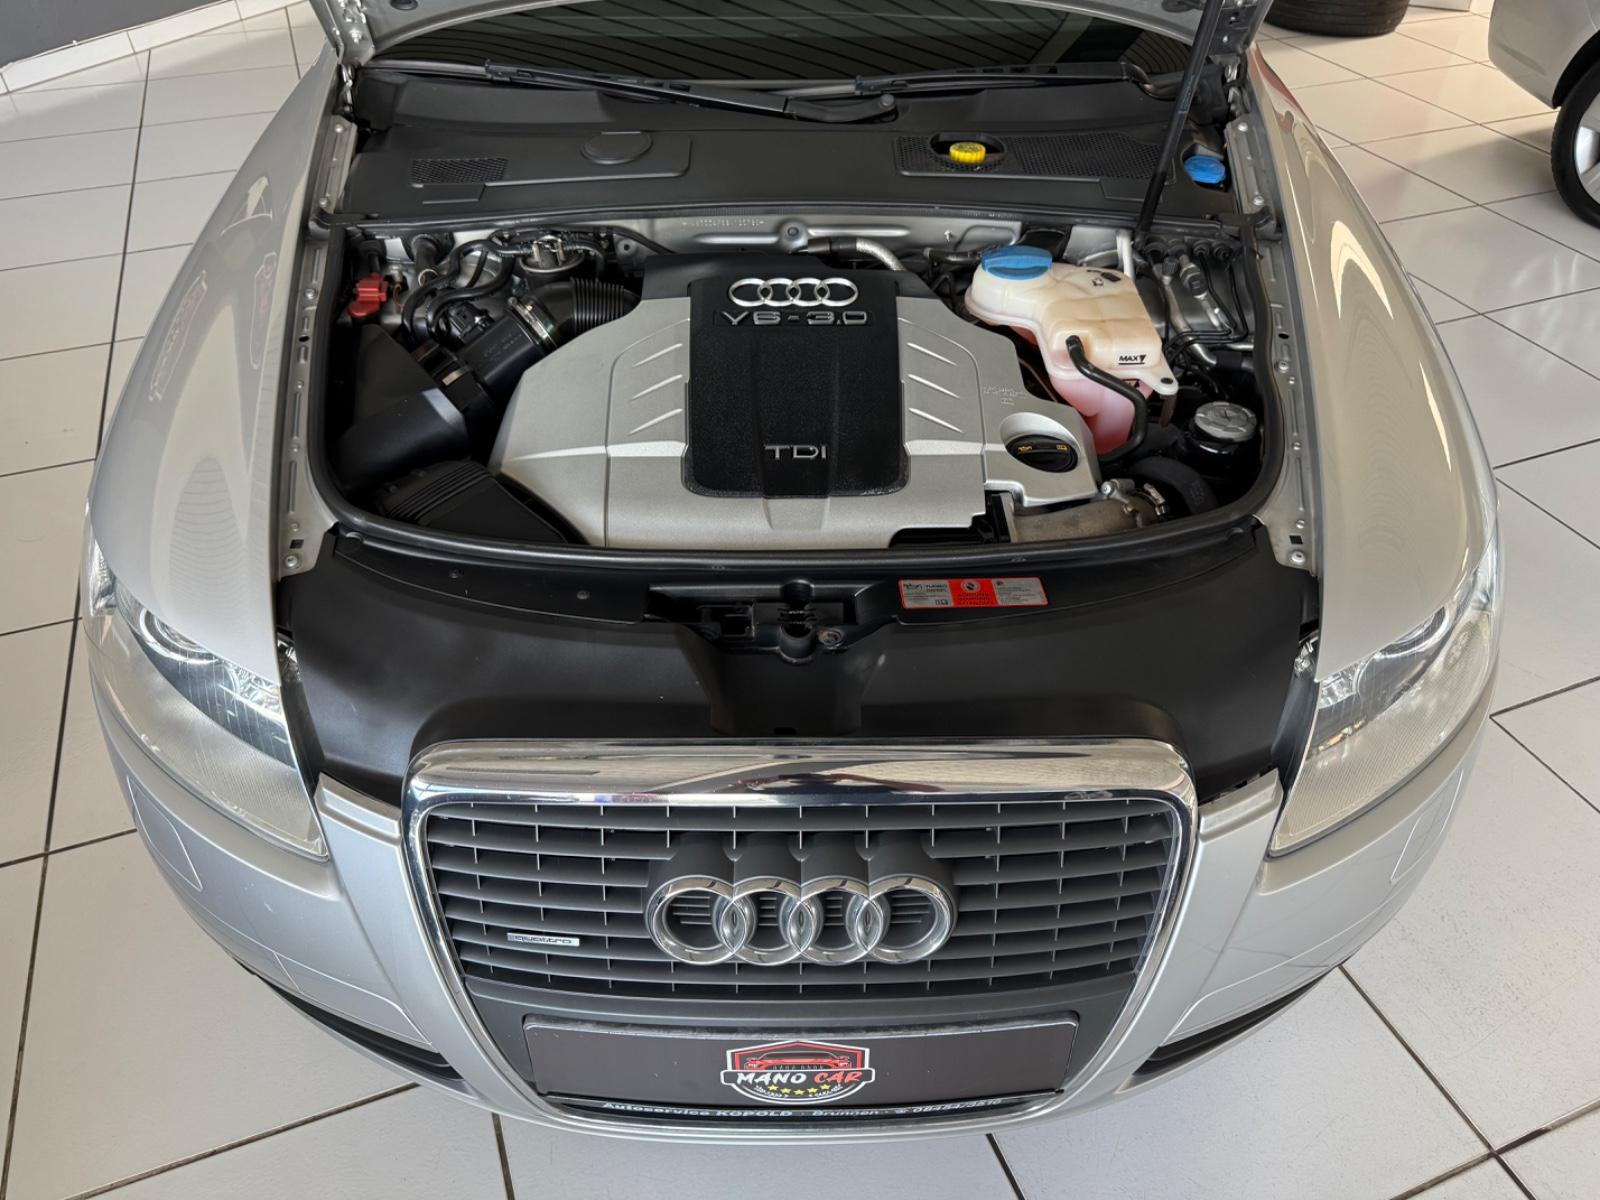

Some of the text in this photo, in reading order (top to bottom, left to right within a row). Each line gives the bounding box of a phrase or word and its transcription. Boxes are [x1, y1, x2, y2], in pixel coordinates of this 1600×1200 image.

[765, 444, 826, 460] TDI
[514, 935, 572, 945] quattro
[736, 1070, 864, 1085] MANO CAR
[603, 1102, 710, 1115] Autoservice
